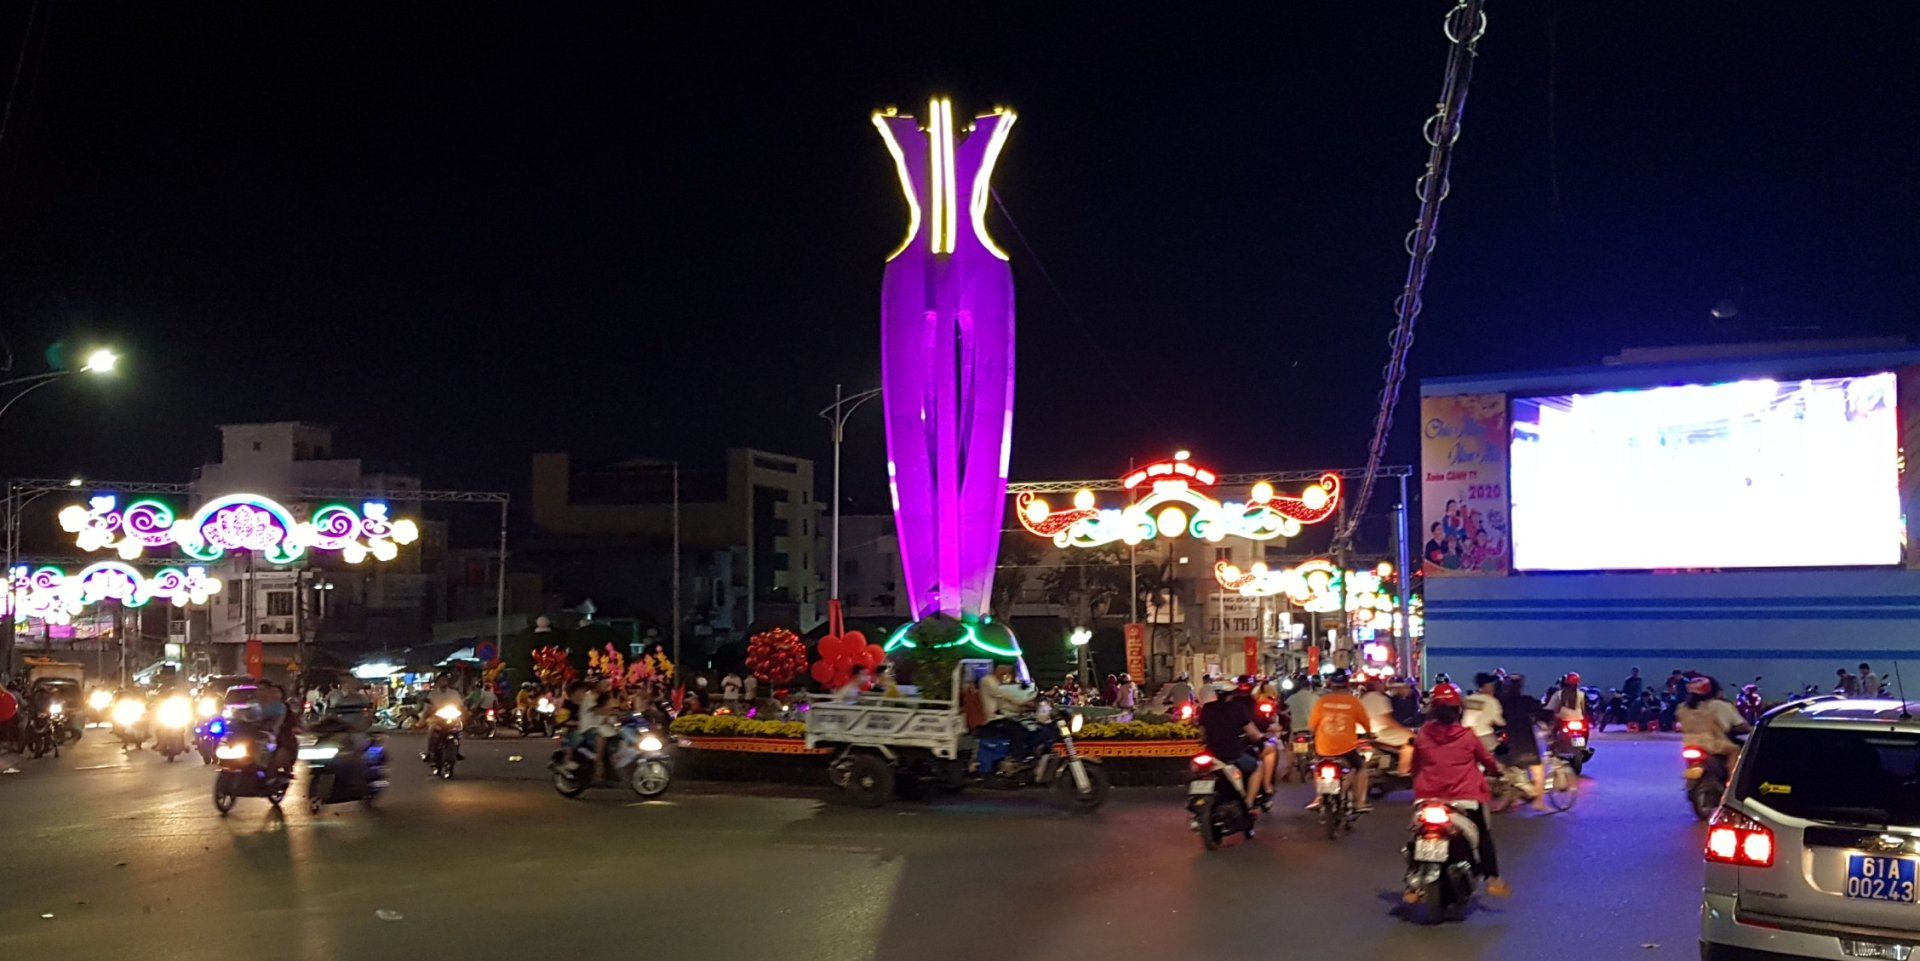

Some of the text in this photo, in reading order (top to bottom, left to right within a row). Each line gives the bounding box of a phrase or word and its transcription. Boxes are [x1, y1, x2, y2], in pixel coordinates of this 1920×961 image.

[1468, 484, 1501, 499] 2020
[1862, 857, 1900, 880] 61A
[1848, 877, 1914, 901] 002.43
